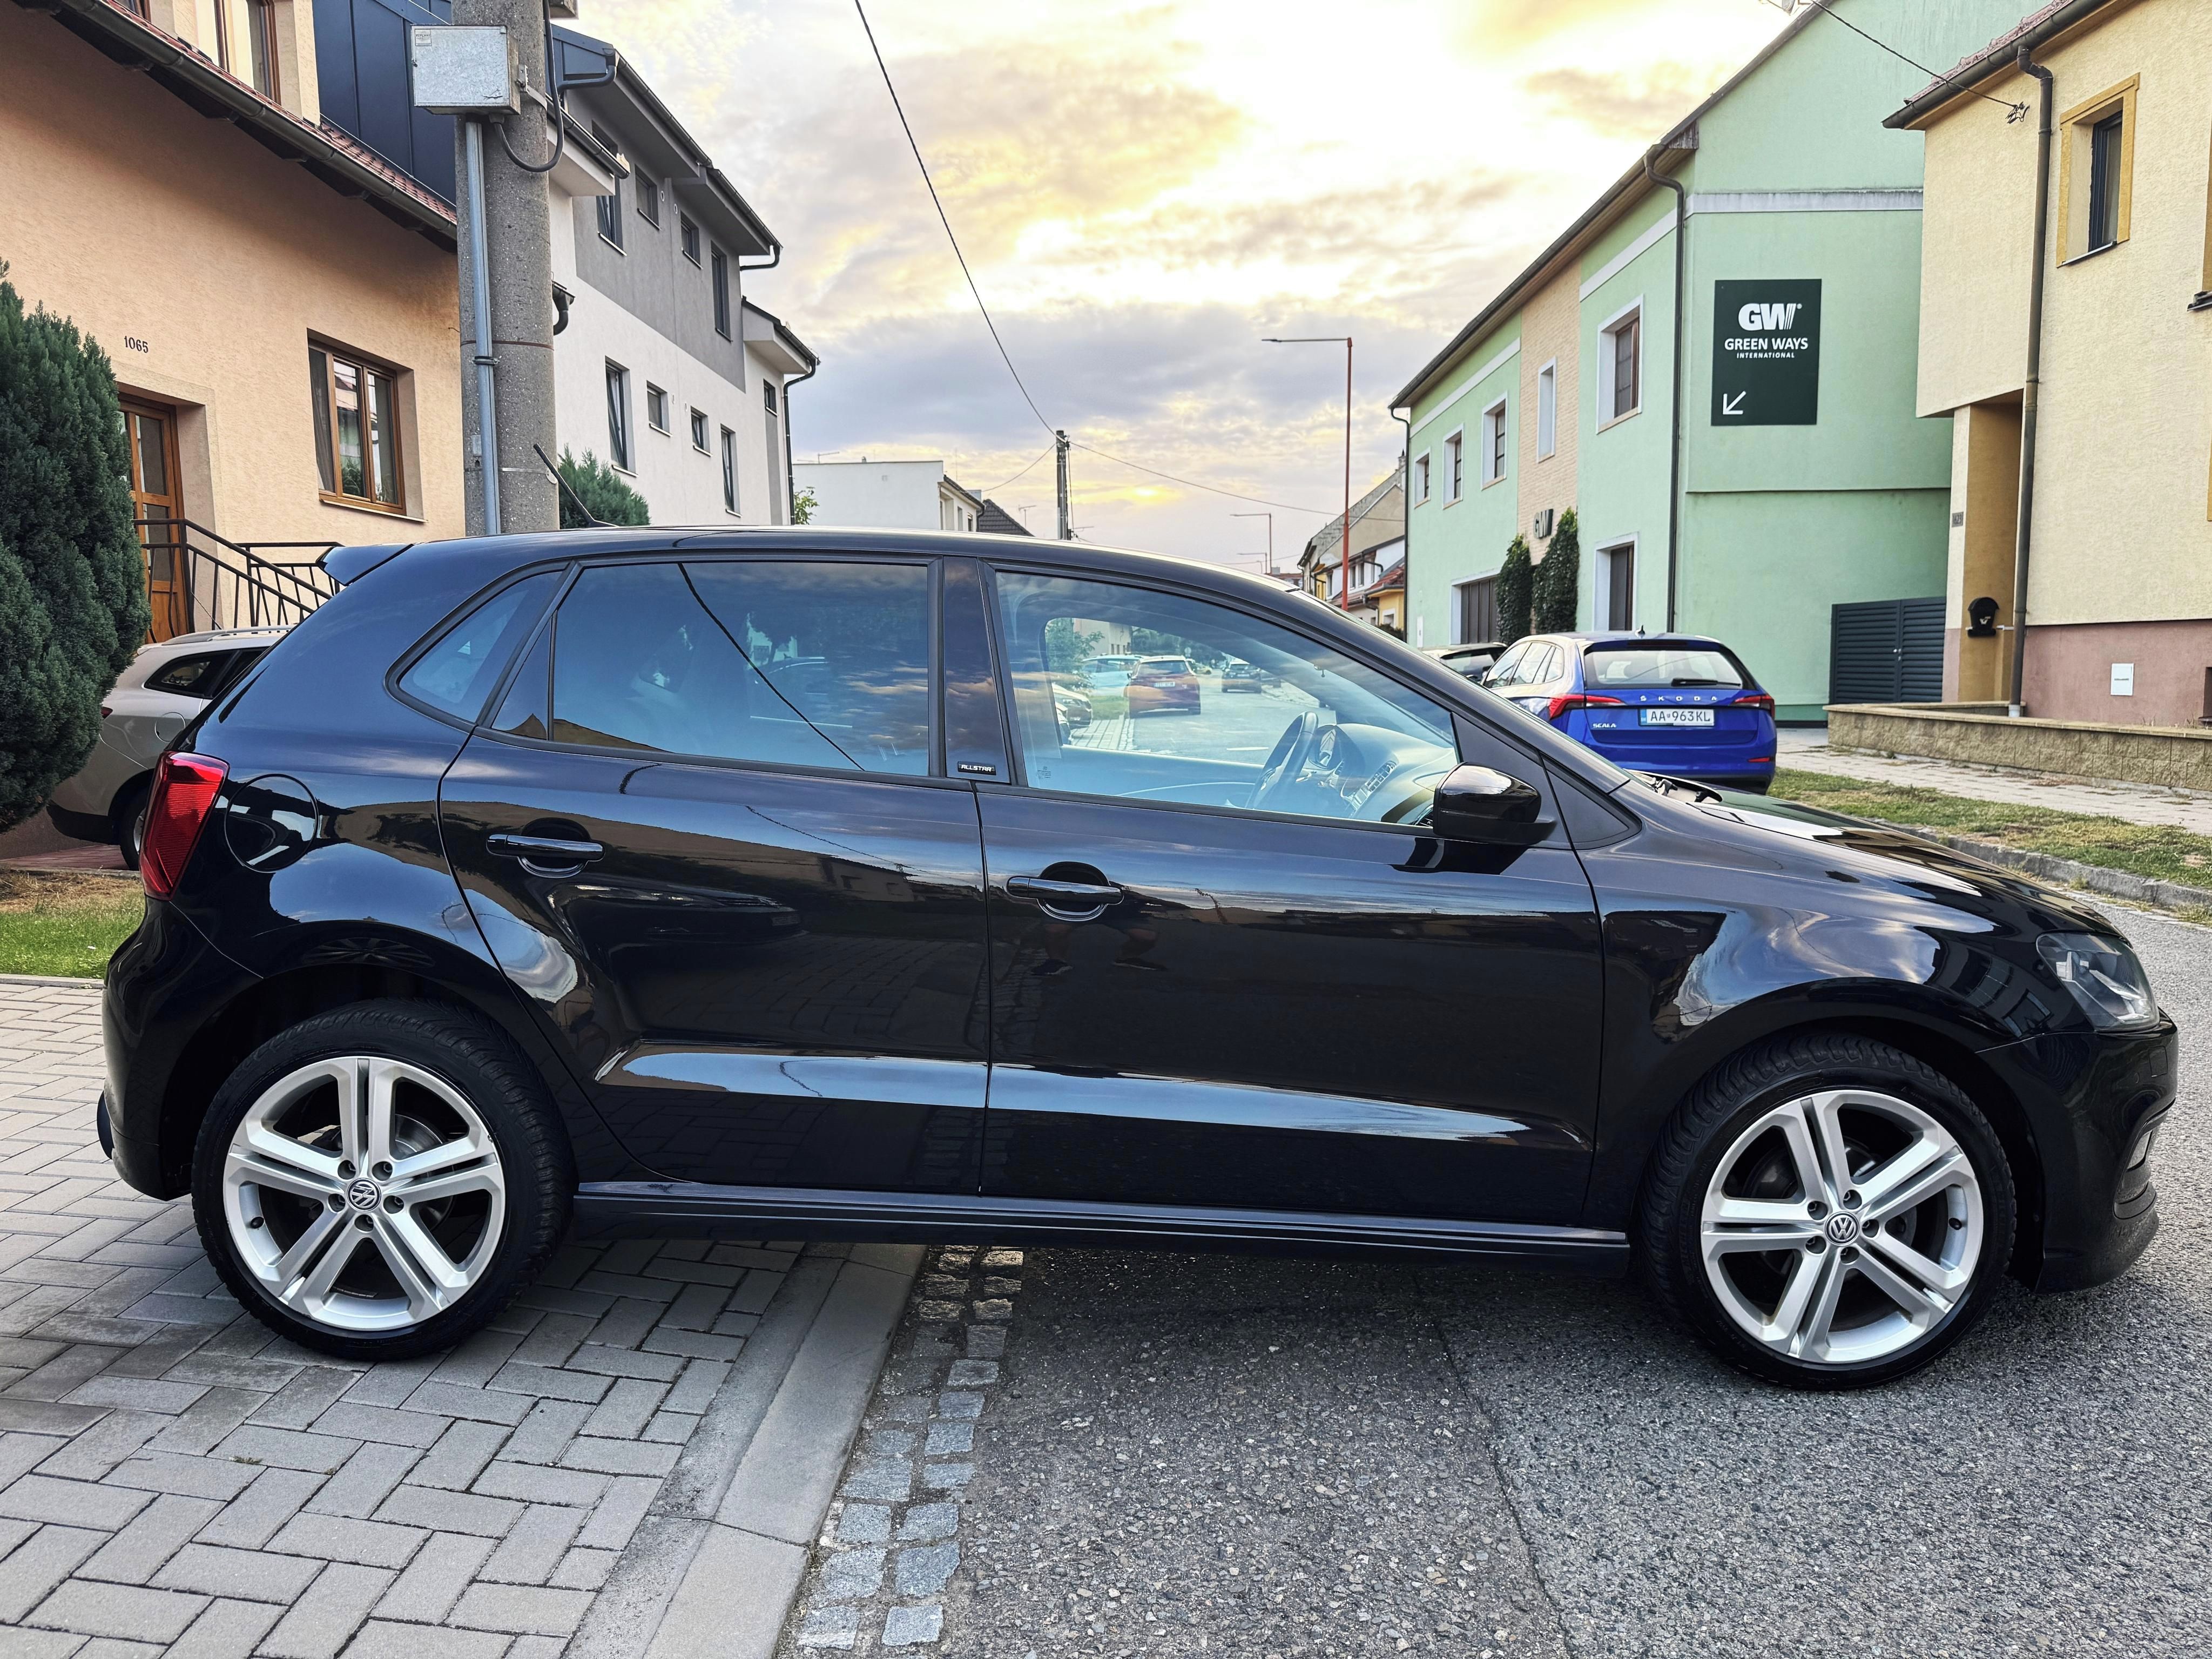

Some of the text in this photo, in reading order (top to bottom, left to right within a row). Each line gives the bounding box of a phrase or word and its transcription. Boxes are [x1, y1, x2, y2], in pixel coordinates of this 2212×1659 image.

[1738, 303, 1797, 331] GW
[124, 335, 149, 353] 1065
[1724, 338, 1808, 350] GREEN WAYS
[1533, 509, 1554, 539] GW
[1650, 711, 1710, 722] AA 963KL
[961, 764, 992, 772] ALLSTAR
